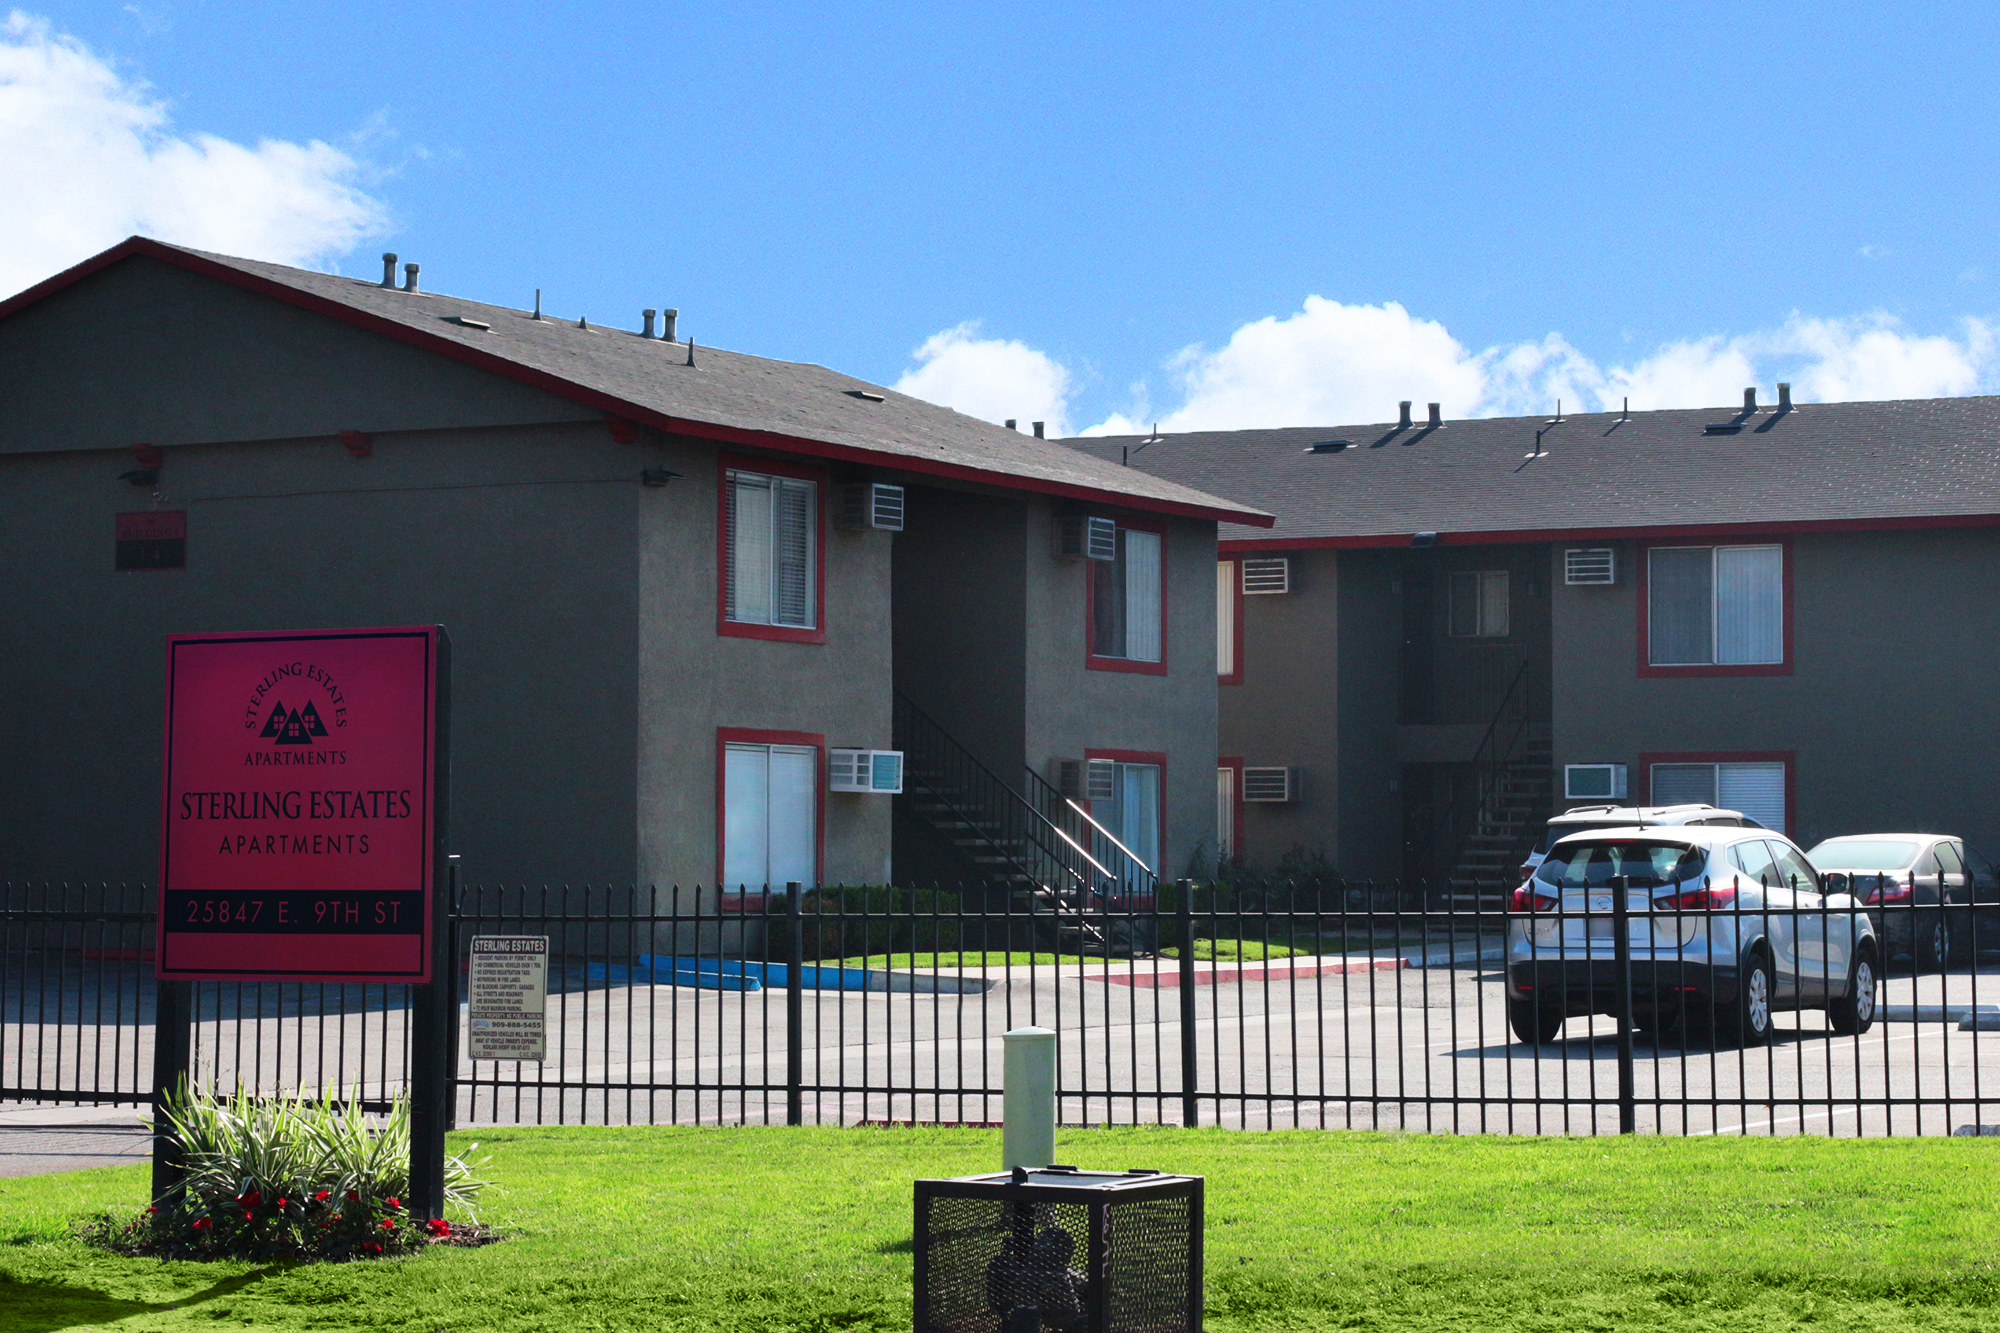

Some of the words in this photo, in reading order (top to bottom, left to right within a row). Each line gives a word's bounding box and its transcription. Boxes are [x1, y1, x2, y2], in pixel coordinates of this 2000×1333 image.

[245, 661, 303, 730] STERLING
[307, 663, 348, 729] ESTATES
[244, 750, 347, 766] APARTMENTS
[180, 790, 302, 821] STERLING
[309, 789, 412, 819] ESTATES
[218, 834, 370, 855] APARTMENTS
[187, 900, 264, 924] 25847
[279, 901, 299, 924] E.
[314, 901, 360, 924] 9TH
[374, 901, 402, 924] ST
[474, 940, 510, 952] STERLING
[511, 940, 545, 952] ESTATES
